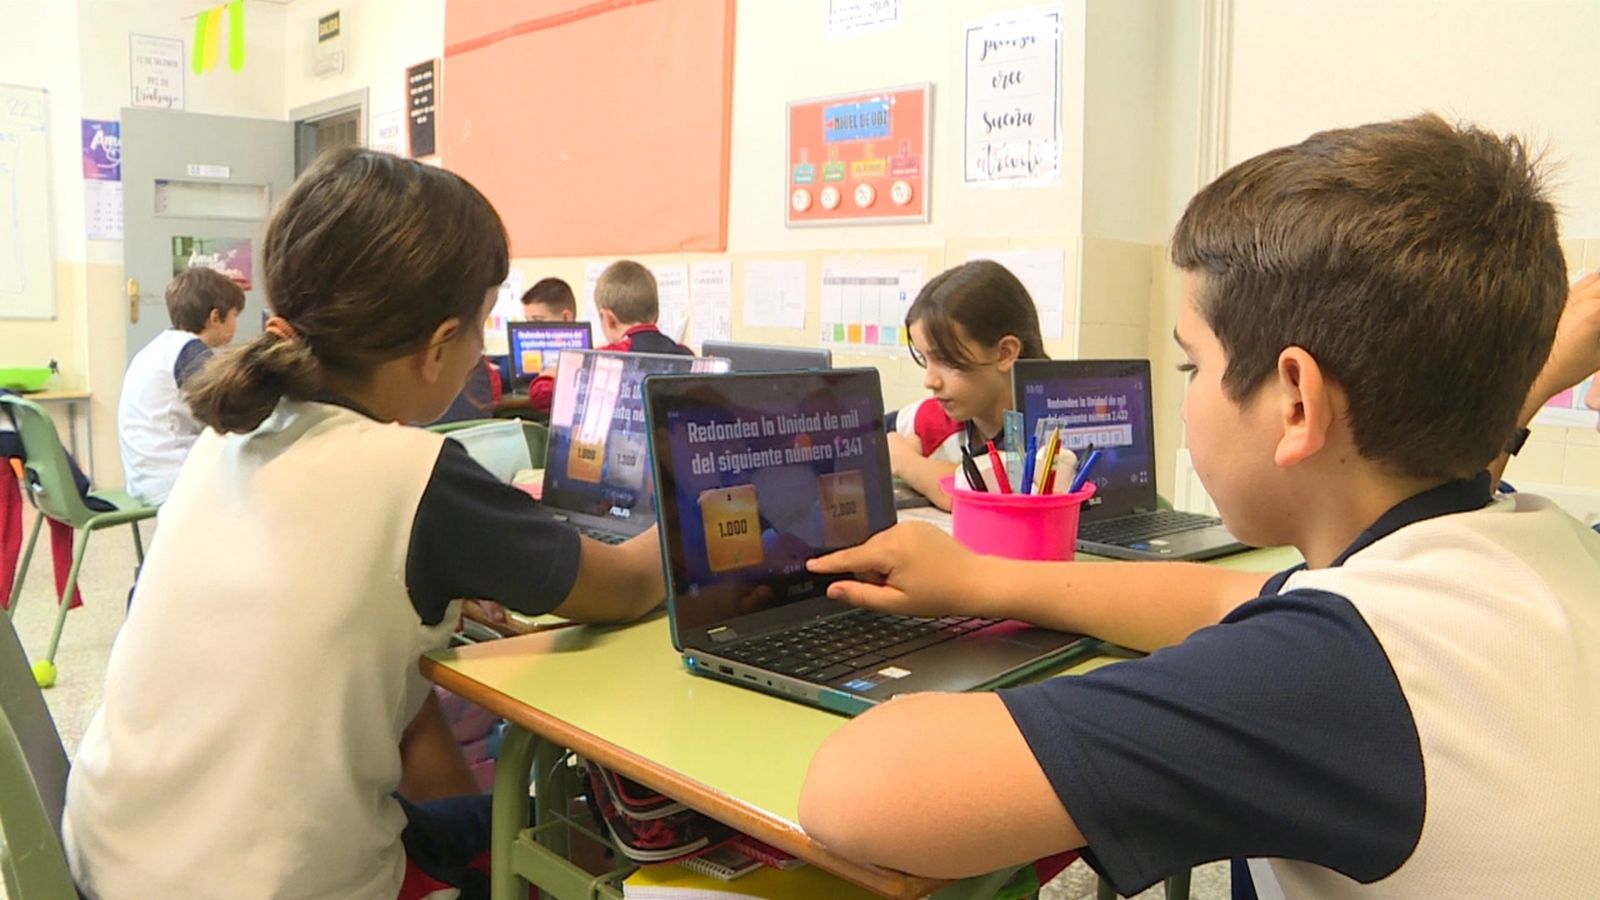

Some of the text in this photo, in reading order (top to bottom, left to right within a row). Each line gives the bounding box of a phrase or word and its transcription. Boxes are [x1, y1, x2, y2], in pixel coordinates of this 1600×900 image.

[687, 410, 860, 443] Redondea la Unidad de mil
[692, 437, 864, 475] del siguiente número 1.341
[832, 501, 857, 517] 2.000
[718, 519, 748, 538] 1.000
